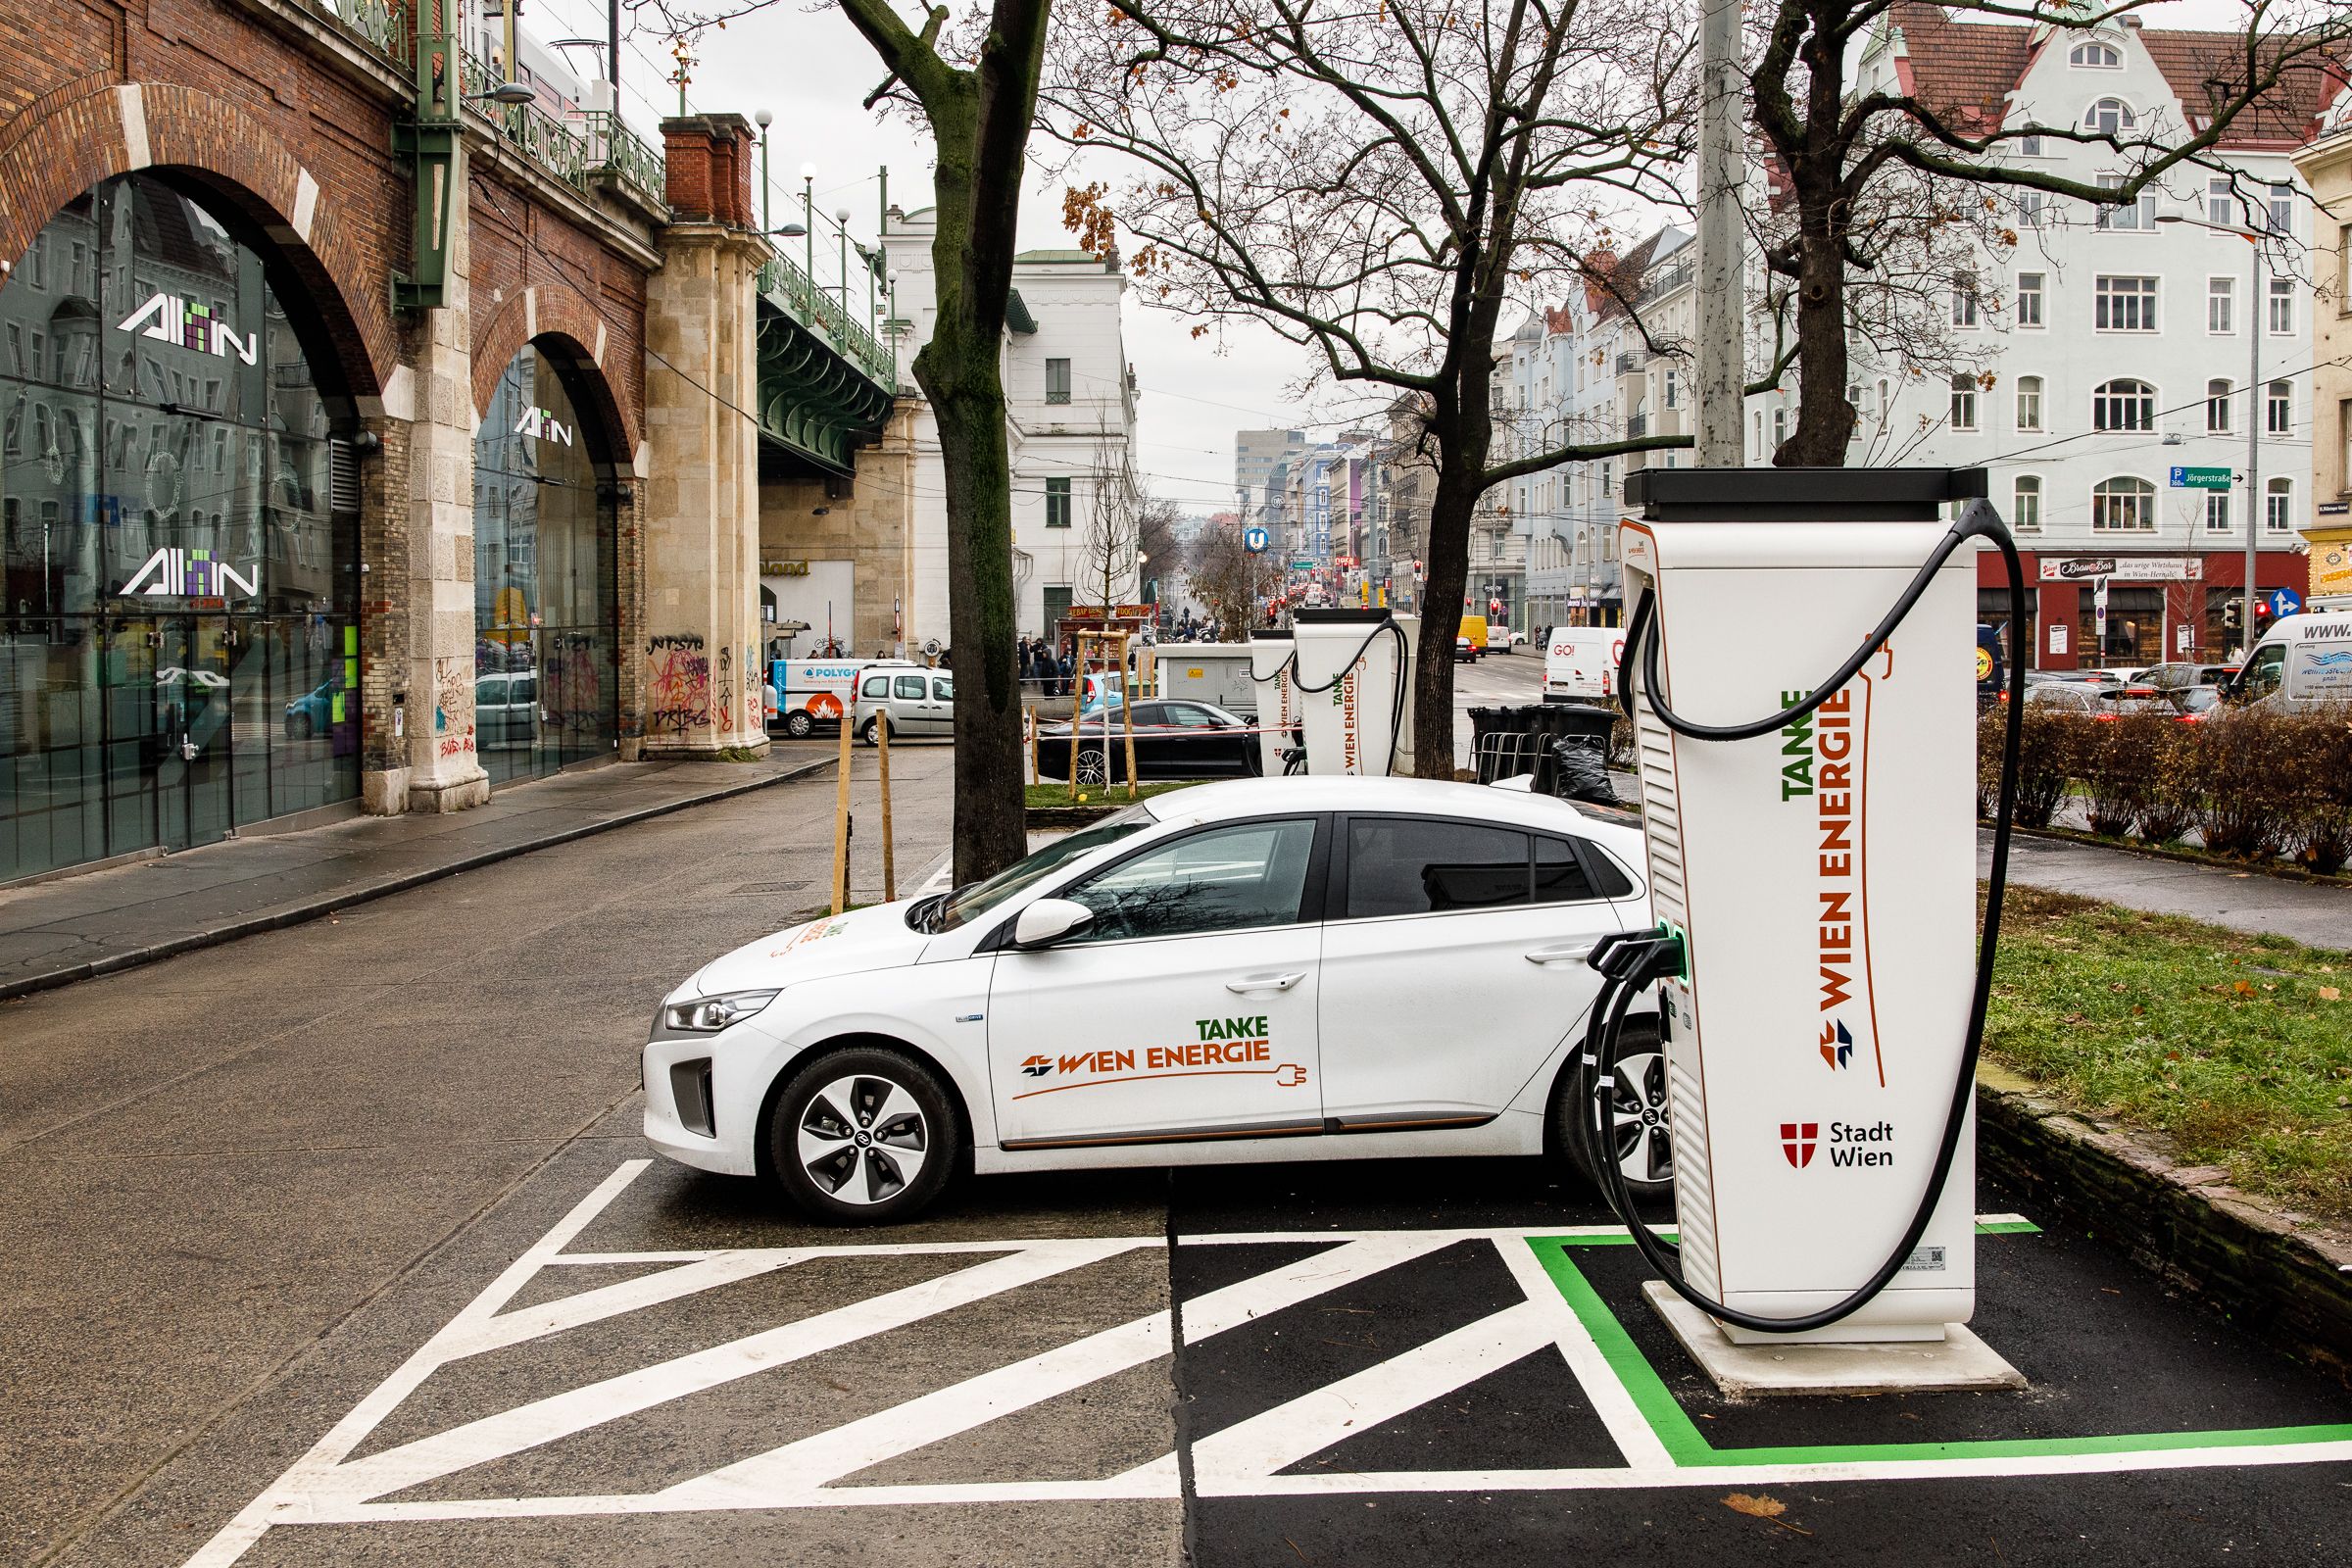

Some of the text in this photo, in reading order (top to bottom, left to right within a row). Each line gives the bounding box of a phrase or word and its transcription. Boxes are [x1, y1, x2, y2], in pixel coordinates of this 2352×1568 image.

[2186, 473, 2230, 483] Jörgerstraße
[1250, 532, 1265, 549] U
[1554, 645, 1575, 656] GO!
[1344, 672, 1355, 768] WIEN ENERGIE
[1819, 689, 1852, 1011] WIEN ENERGIE
[1196, 1015, 1269, 1041] TANKE
[1058, 1040, 1270, 1075] WIEN ENERGIE
[1831, 1121, 1893, 1143] Stadt
[1831, 1147, 1893, 1167] Wien
